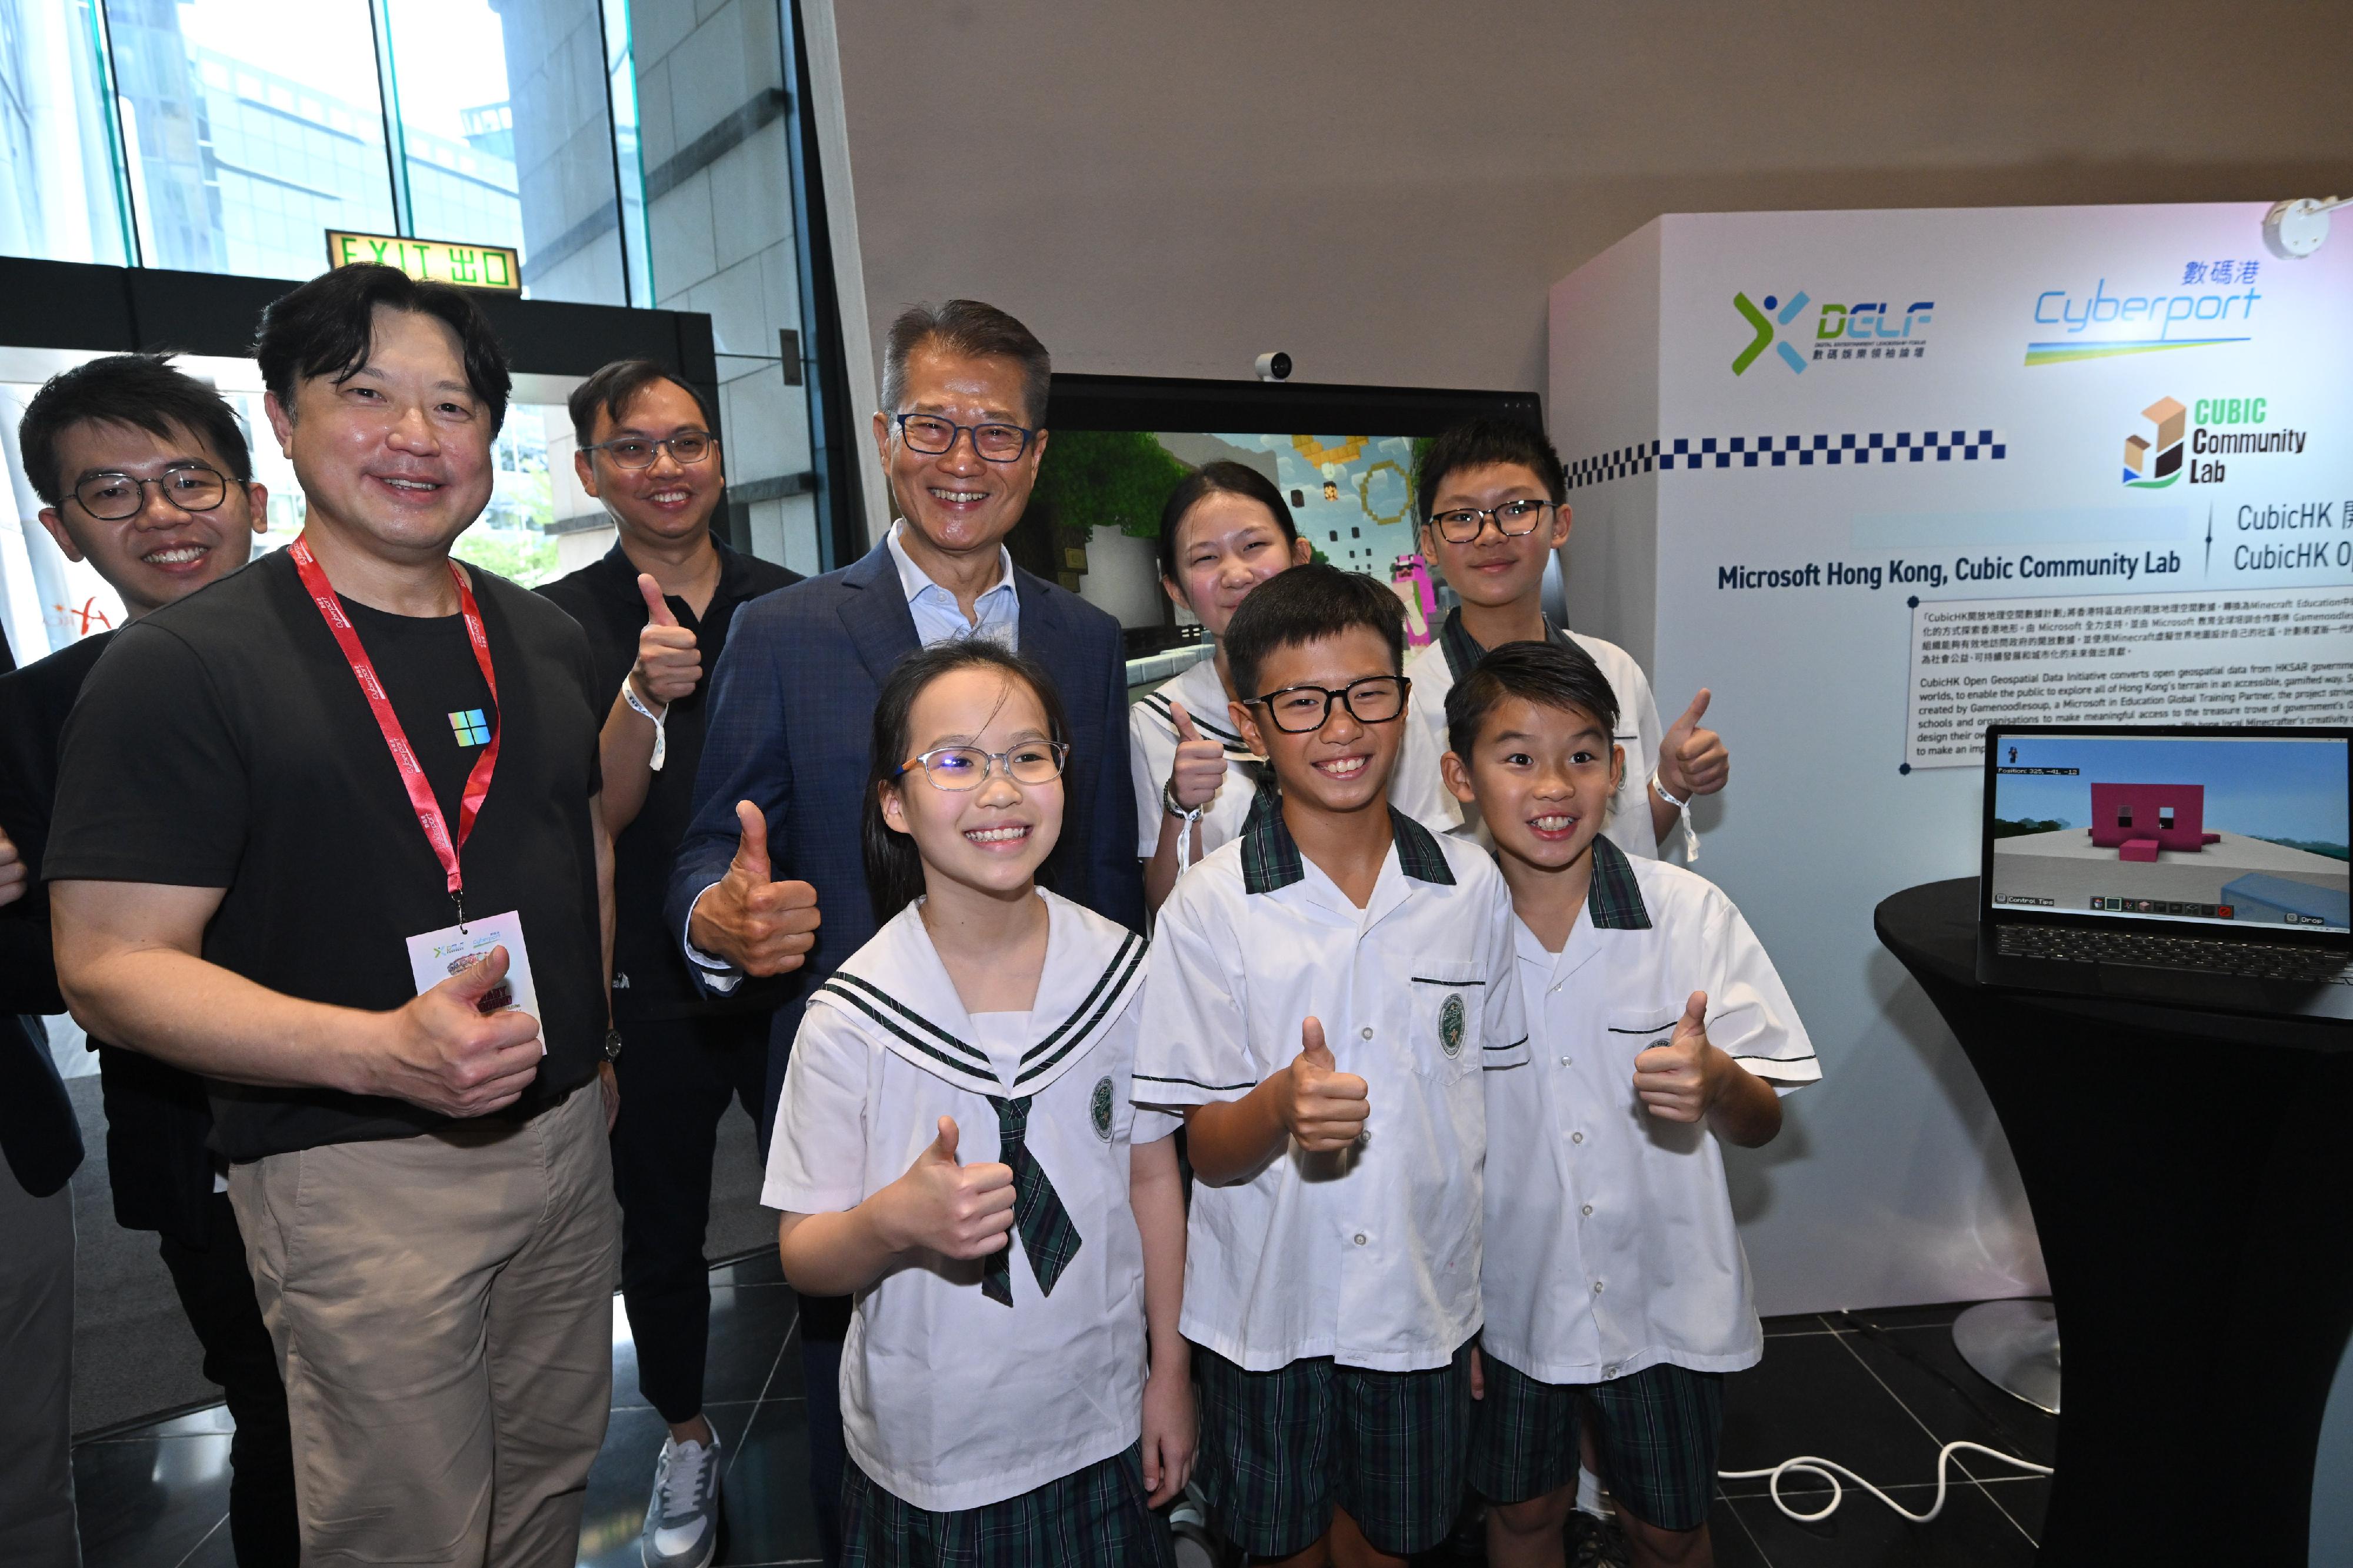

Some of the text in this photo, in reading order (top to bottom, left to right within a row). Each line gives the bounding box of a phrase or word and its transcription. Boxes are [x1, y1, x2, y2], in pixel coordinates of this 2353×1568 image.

[342, 236, 509, 286] EXIT 出口
[2181, 259, 2259, 286] 數碼港
[1817, 302, 1935, 339] DELF
[2034, 278, 2262, 341] Cyberport
[2194, 397, 2267, 425] CUBIC
[2192, 428, 2307, 454] Community
[2189, 459, 2226, 484] Lab
[2238, 501, 2333, 531] CubicHK
[1718, 550, 2181, 591] Microsoft Hong Kong, Cubic Community Lab
[2234, 541, 2353, 573] CubicHK O
[2038, 622, 2082, 632] Microsoft
[2152, 617, 2194, 628] Microsoft
[358, 663, 379, 700] Cyberport
[1919, 691, 1954, 702] worlds,
[1956, 692, 1965, 700] to
[1967, 689, 1998, 699] enable
[2000, 688, 2014, 698] the
[2017, 687, 2045, 699] public
[2047, 687, 2057, 696] to
[2058, 686, 2092, 696] explore
[2094, 683, 2105, 693] all
[2107, 683, 2117, 693] of
[2118, 683, 2143, 694] Hong
[2144, 682, 2175, 693] Kong's
[2178, 681, 2209, 690] terrain
[2211, 680, 2219, 689] in
[2220, 680, 2231, 688] an
[2284, 675, 2322, 688] gamified
[1920, 678, 1960, 688] CubicHK
[1964, 676, 1987, 687] Open
[1991, 673, 2039, 686] Geospatial
[2042, 673, 2064, 682] Data
[2067, 671, 2107, 681] Initiative
[2109, 670, 2150, 680] converts
[2153, 670, 2176, 679] open
[2178, 666, 2224, 678] geospatial
[2227, 666, 2247, 675] data
[2250, 665, 2272, 673] from
[2275, 662, 2309, 673] HKSAR
[1918, 704, 1953, 715] created
[1956, 704, 1968, 715] by
[1970, 700, 2051, 713] Gamenoodlesoup,
[2054, 700, 2061, 709] a
[2062, 698, 2106, 708] Microsoft
[2109, 697, 2118, 706] in
[2120, 695, 2165, 706] Education
[2167, 694, 2196, 704] Global
[2199, 693, 2235, 704] Training
[2277, 690, 2292, 699] the
[2295, 689, 2327, 700] project
[1918, 718, 1953, 729] schools
[1957, 717, 1974, 727] and
[1977, 714, 2039, 725] organisations
[2042, 715, 2052, 723] to
[2055, 712, 2079, 722] make
[2083, 709, 2135, 722] meaningful
[2138, 710, 2169, 719] access
[2184, 708, 2199, 716] the
[2202, 707, 2240, 716] treasure
[2244, 706, 2268, 714] trove
[2271, 704, 2281, 713] of
[2284, 701, 2344, 715] government's
[2307, 715, 2349, 725] creativity
[1917, 732, 1948, 743] design
[1950, 730, 1972, 741] their
[1917, 747, 1926, 755] to
[1928, 745, 1953, 755] make
[1956, 746, 1967, 754] an
[394, 738, 414, 775] Cyberport
[2008, 896, 2036, 905] Control
[2301, 916, 2324, 925] Drop
